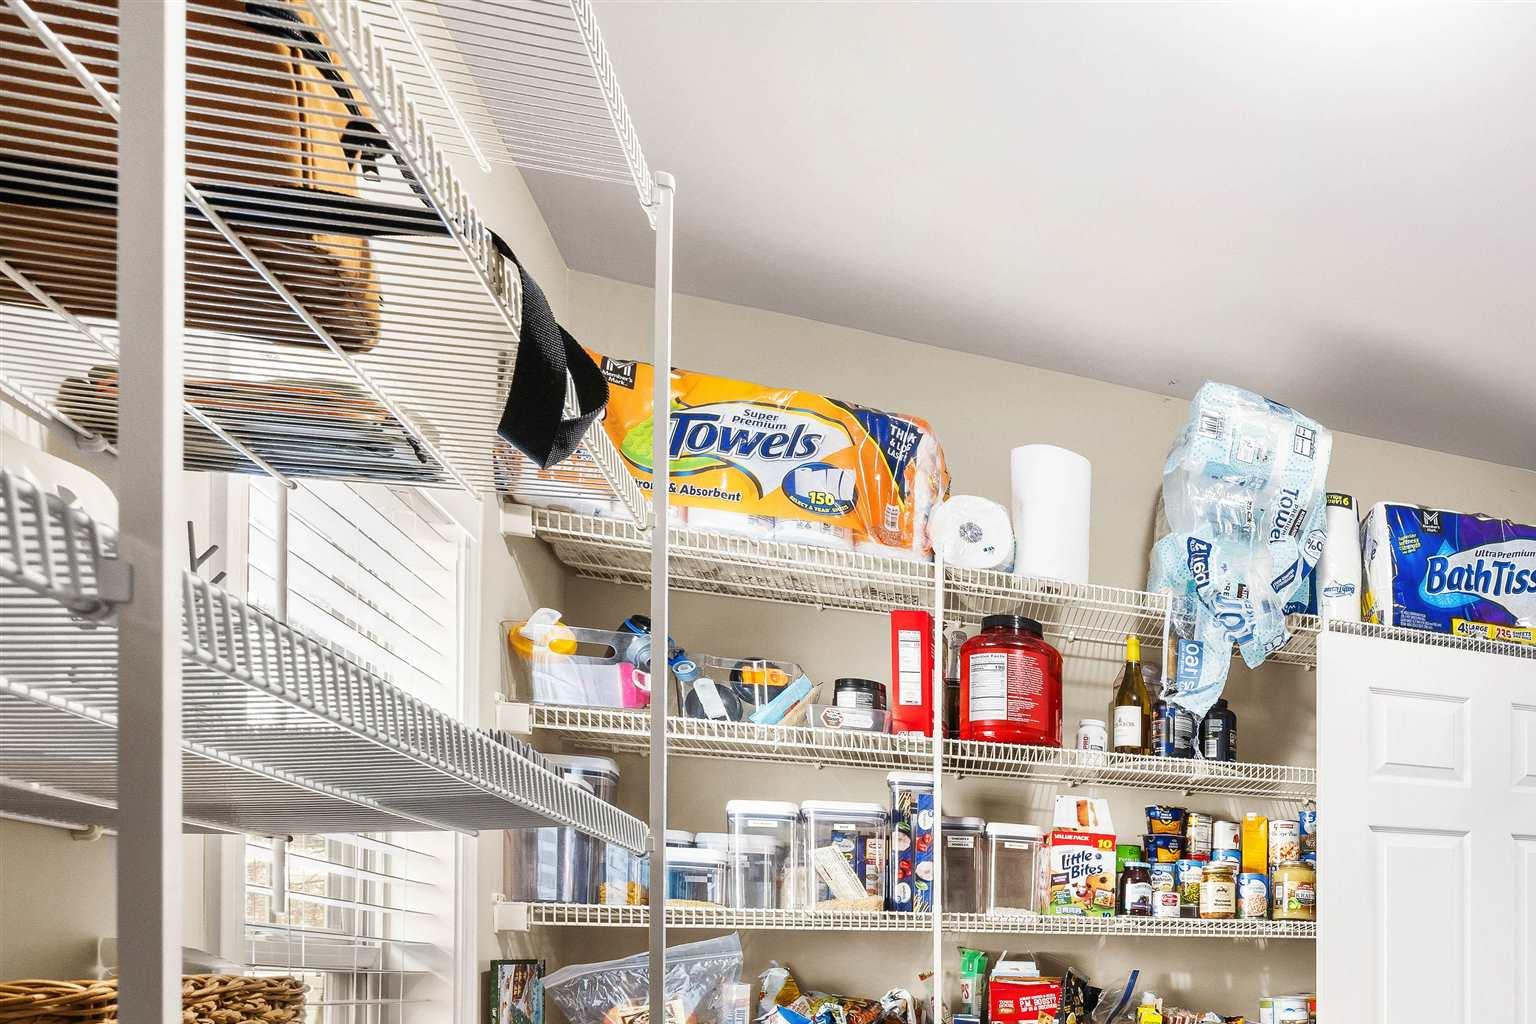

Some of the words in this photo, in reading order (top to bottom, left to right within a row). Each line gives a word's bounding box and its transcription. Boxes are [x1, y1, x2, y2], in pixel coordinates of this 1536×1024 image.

[602, 369, 633, 383] Member's
[743, 409, 780, 421] Super
[732, 415, 787, 431] Premium
[669, 412, 822, 460] Towels
[669, 483, 677, 493] &
[680, 485, 741, 501] Absorbent
[808, 491, 835, 505] 150
[1098, 839, 1113, 849] 10
[1062, 851, 1092, 871] Little
[1071, 864, 1104, 879] Bites
